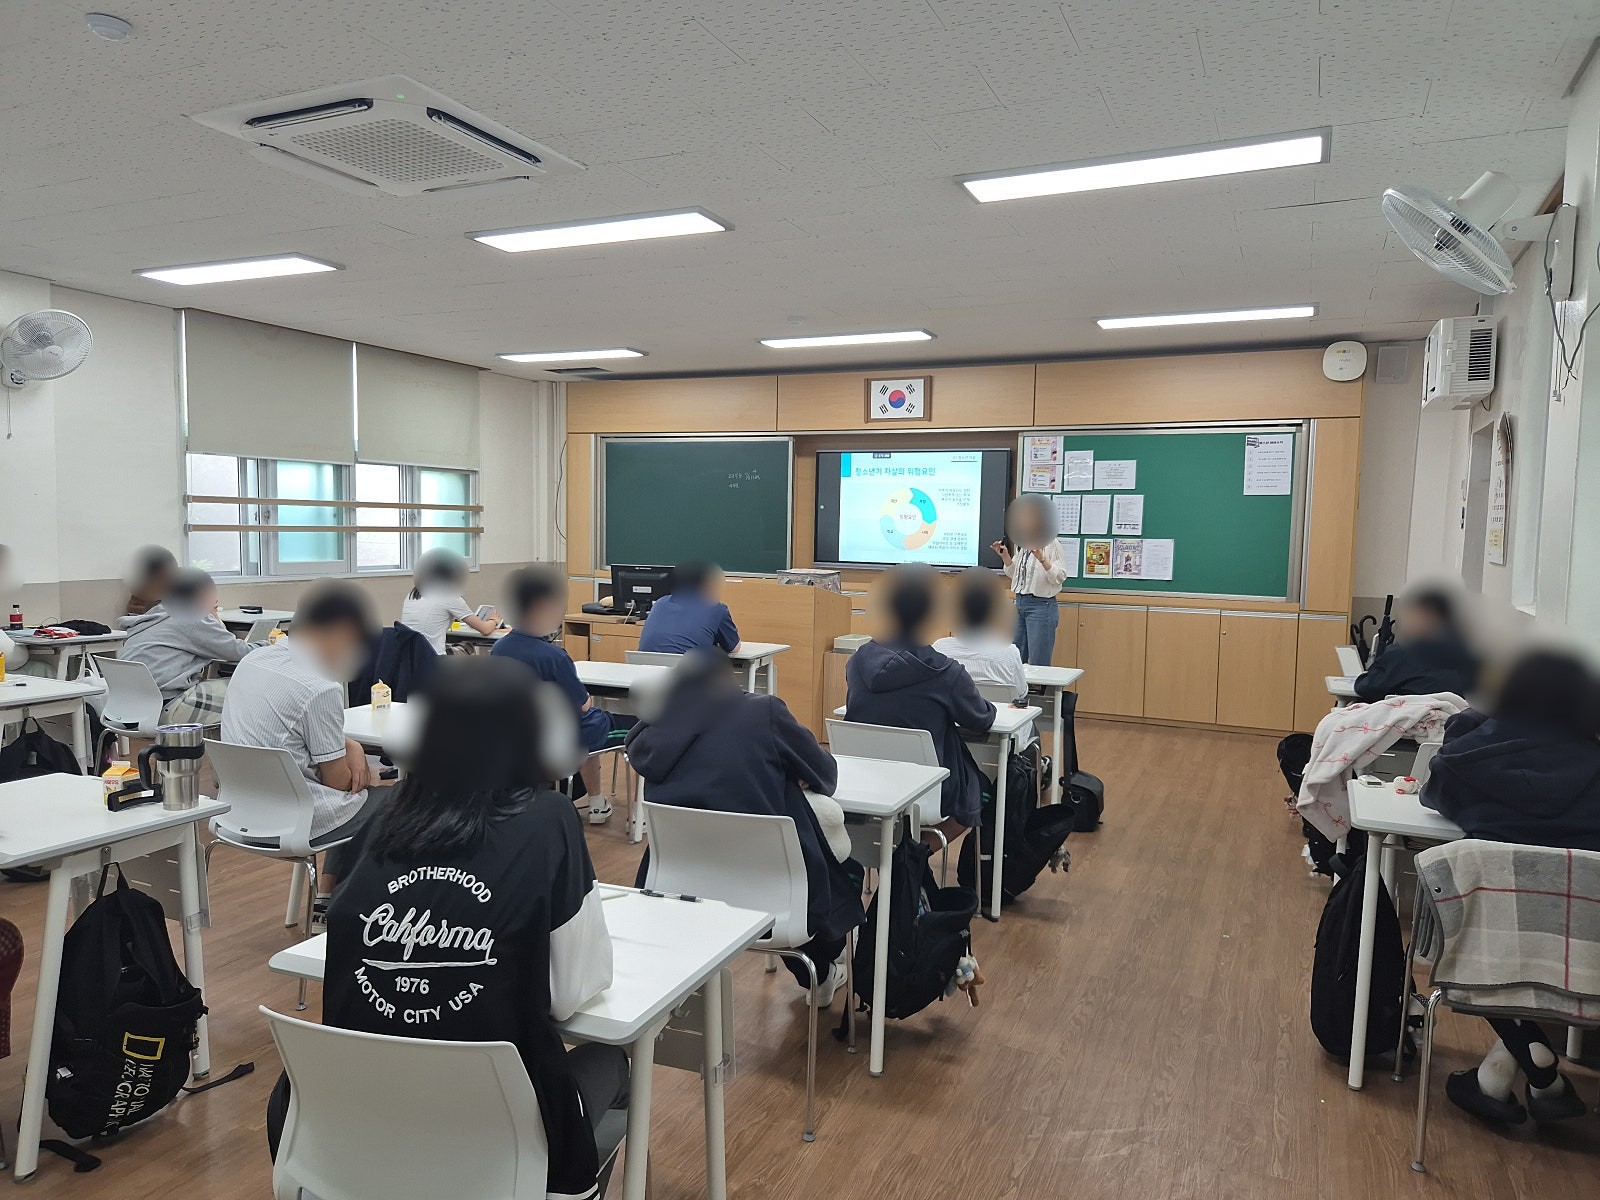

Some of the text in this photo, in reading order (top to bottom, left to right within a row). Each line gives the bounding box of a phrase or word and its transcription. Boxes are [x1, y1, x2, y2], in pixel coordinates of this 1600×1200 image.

[855, 467, 936, 476] 청소년기 자살의 위험요인
[387, 866, 492, 903] BROTHERHOOD
[354, 966, 485, 1024] MOTOR CITY USA
[395, 976, 430, 995] 1976
[127, 1063, 155, 1116] NAIOAL
